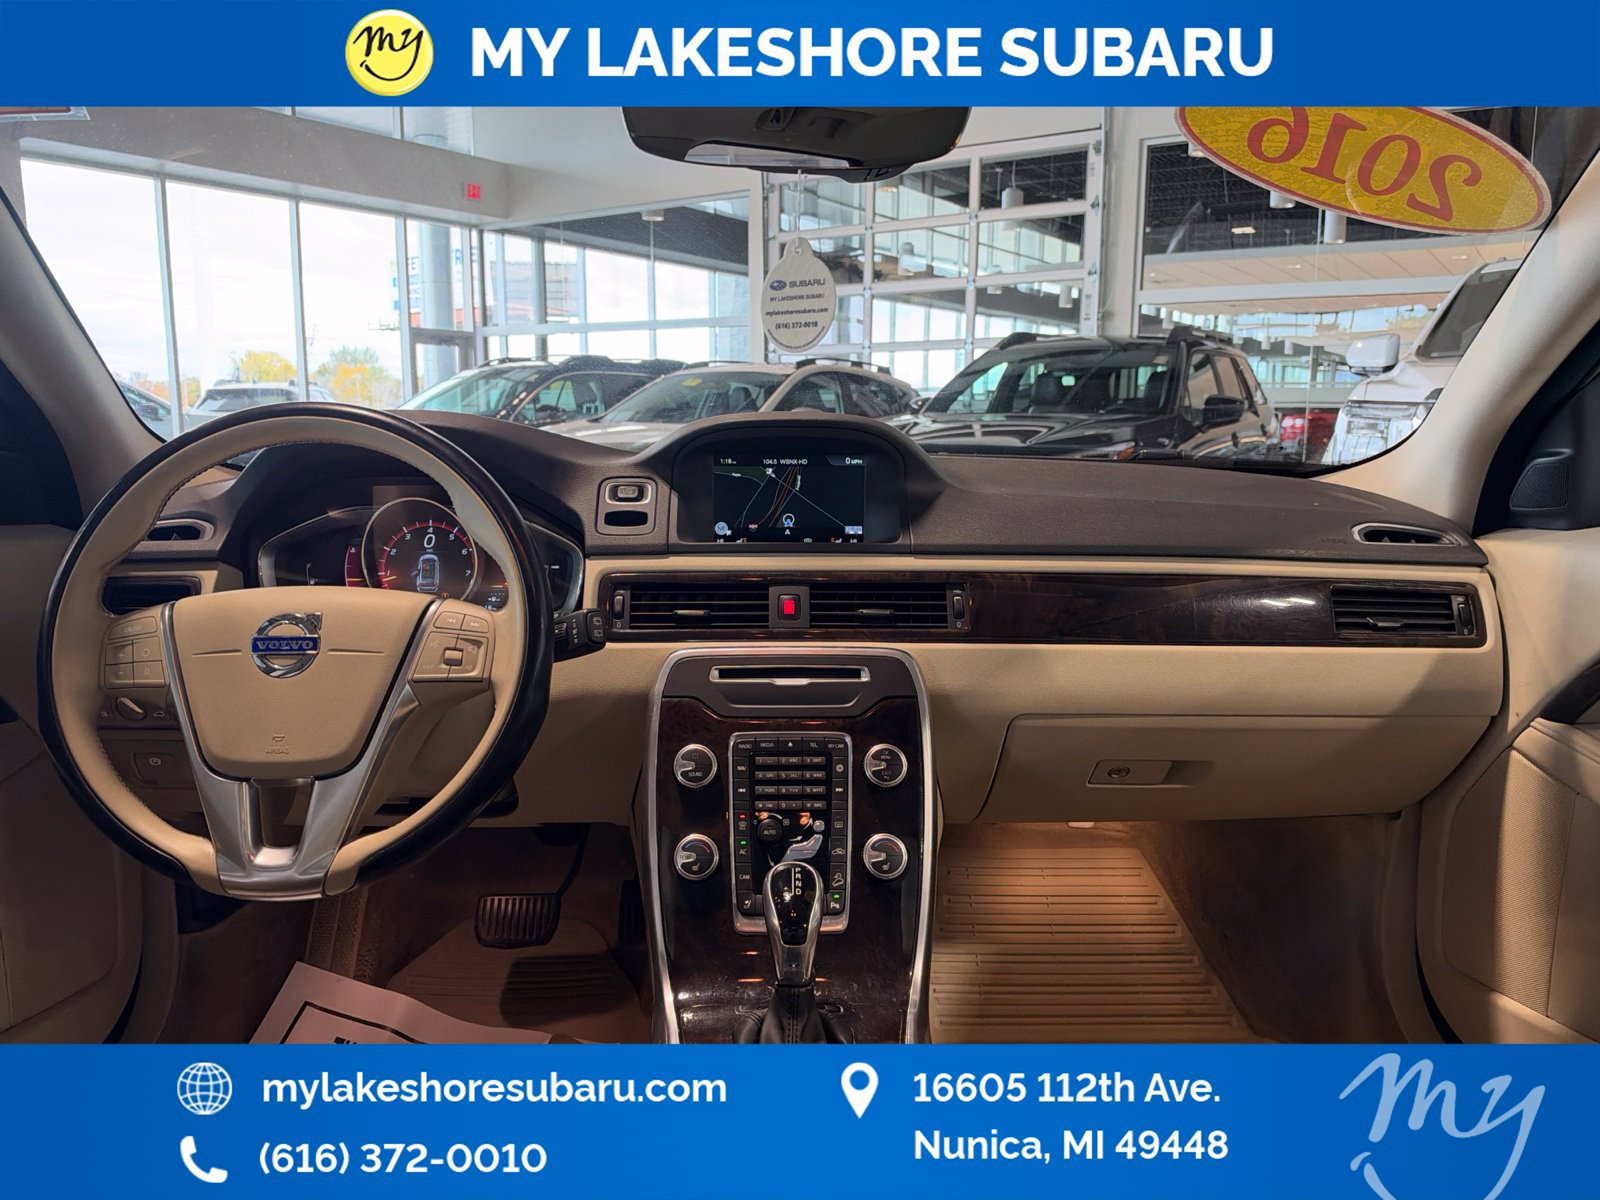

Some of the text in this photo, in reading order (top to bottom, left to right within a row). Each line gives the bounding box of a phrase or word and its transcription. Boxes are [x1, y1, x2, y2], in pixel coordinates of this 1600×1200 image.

[789, 279, 825, 288] SUBARU
[766, 307, 828, 317] mylakeshoresubaru.com
[775, 321, 818, 330] (616) 372-0010
[424, 534, 436, 548] 0
[256, 640, 314, 649] VOLVO
